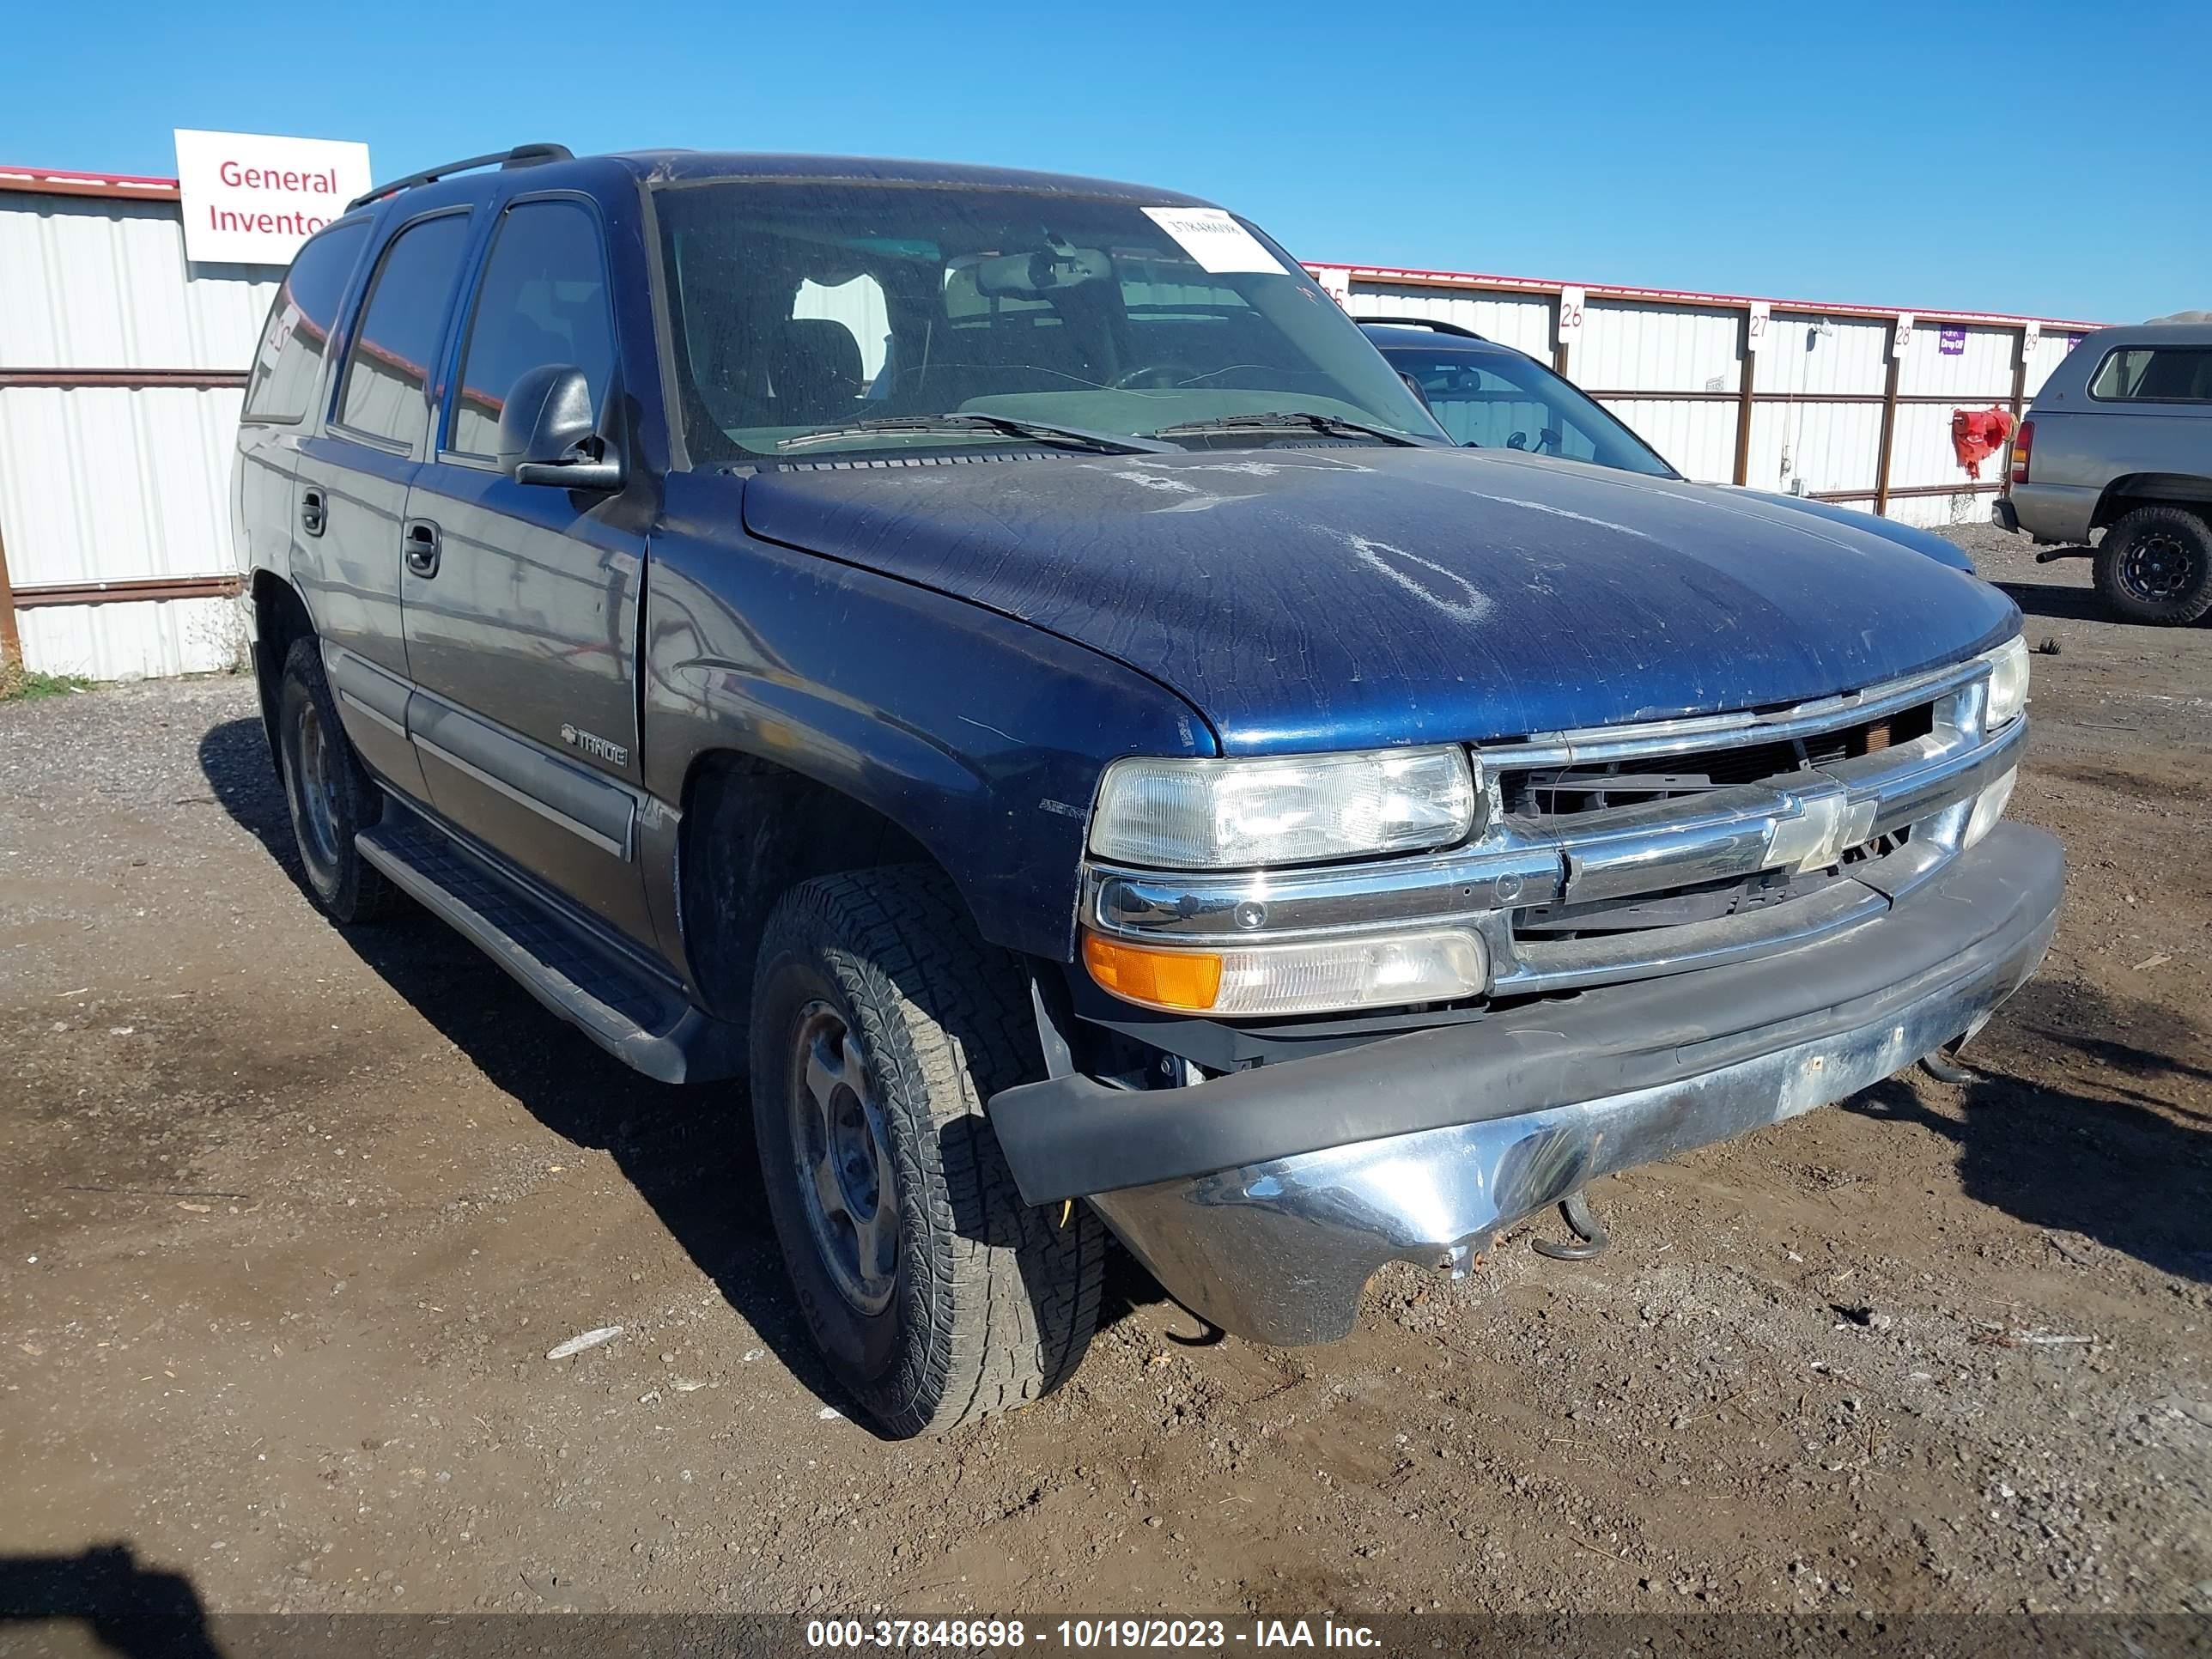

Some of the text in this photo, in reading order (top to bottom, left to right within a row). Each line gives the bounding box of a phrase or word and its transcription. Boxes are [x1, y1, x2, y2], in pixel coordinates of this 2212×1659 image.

[220, 161, 337, 195] General
[210, 204, 332, 235] Invento
[1561, 303, 1582, 327] 26
[1750, 315, 1768, 337] 27
[1895, 325, 1911, 345] 28
[2025, 333, 2038, 350] 29
[577, 728, 628, 768] TAHOE
